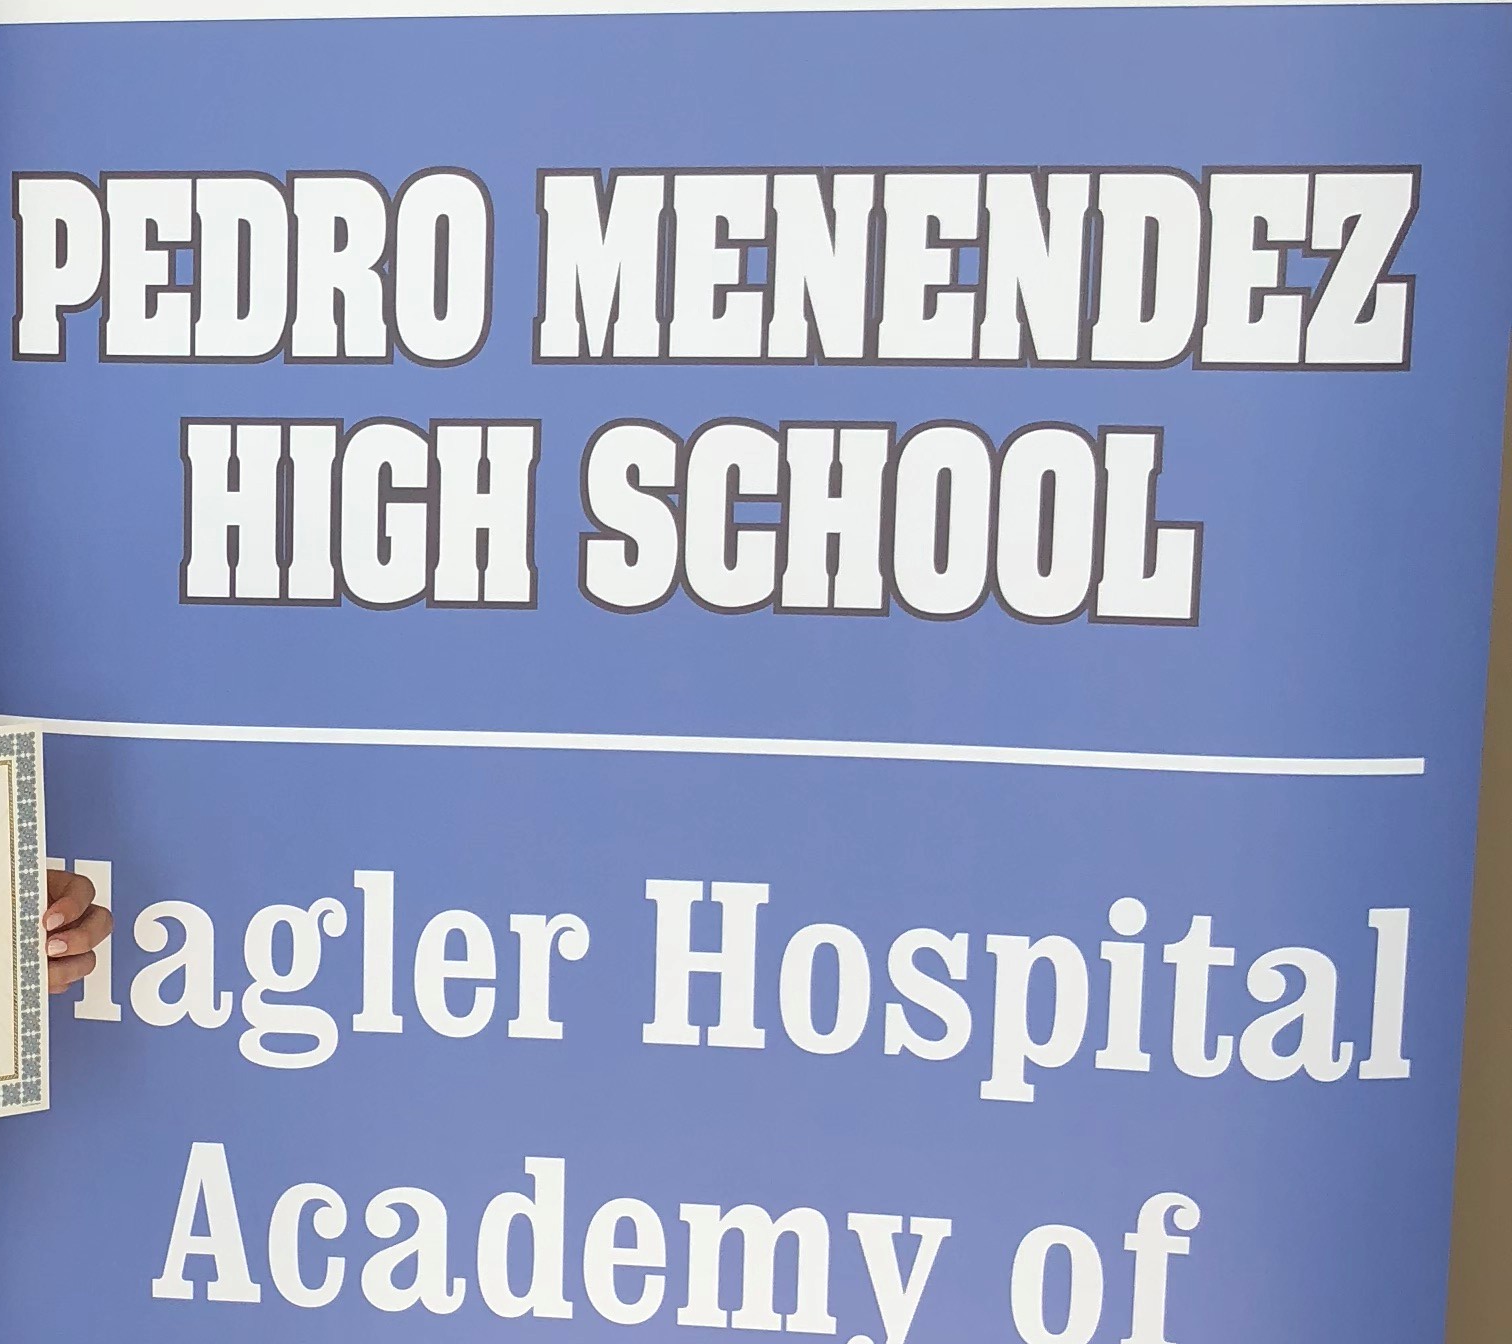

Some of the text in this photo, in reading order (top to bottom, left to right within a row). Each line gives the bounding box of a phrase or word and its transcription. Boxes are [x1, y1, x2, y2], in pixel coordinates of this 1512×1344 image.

[11, 165, 1422, 371] PEDRO MENENDEZ
[180, 417, 1203, 626] HIGH SCHOOL
[46, 858, 590, 1070] lagler
[642, 878, 1411, 1103] Hospital
